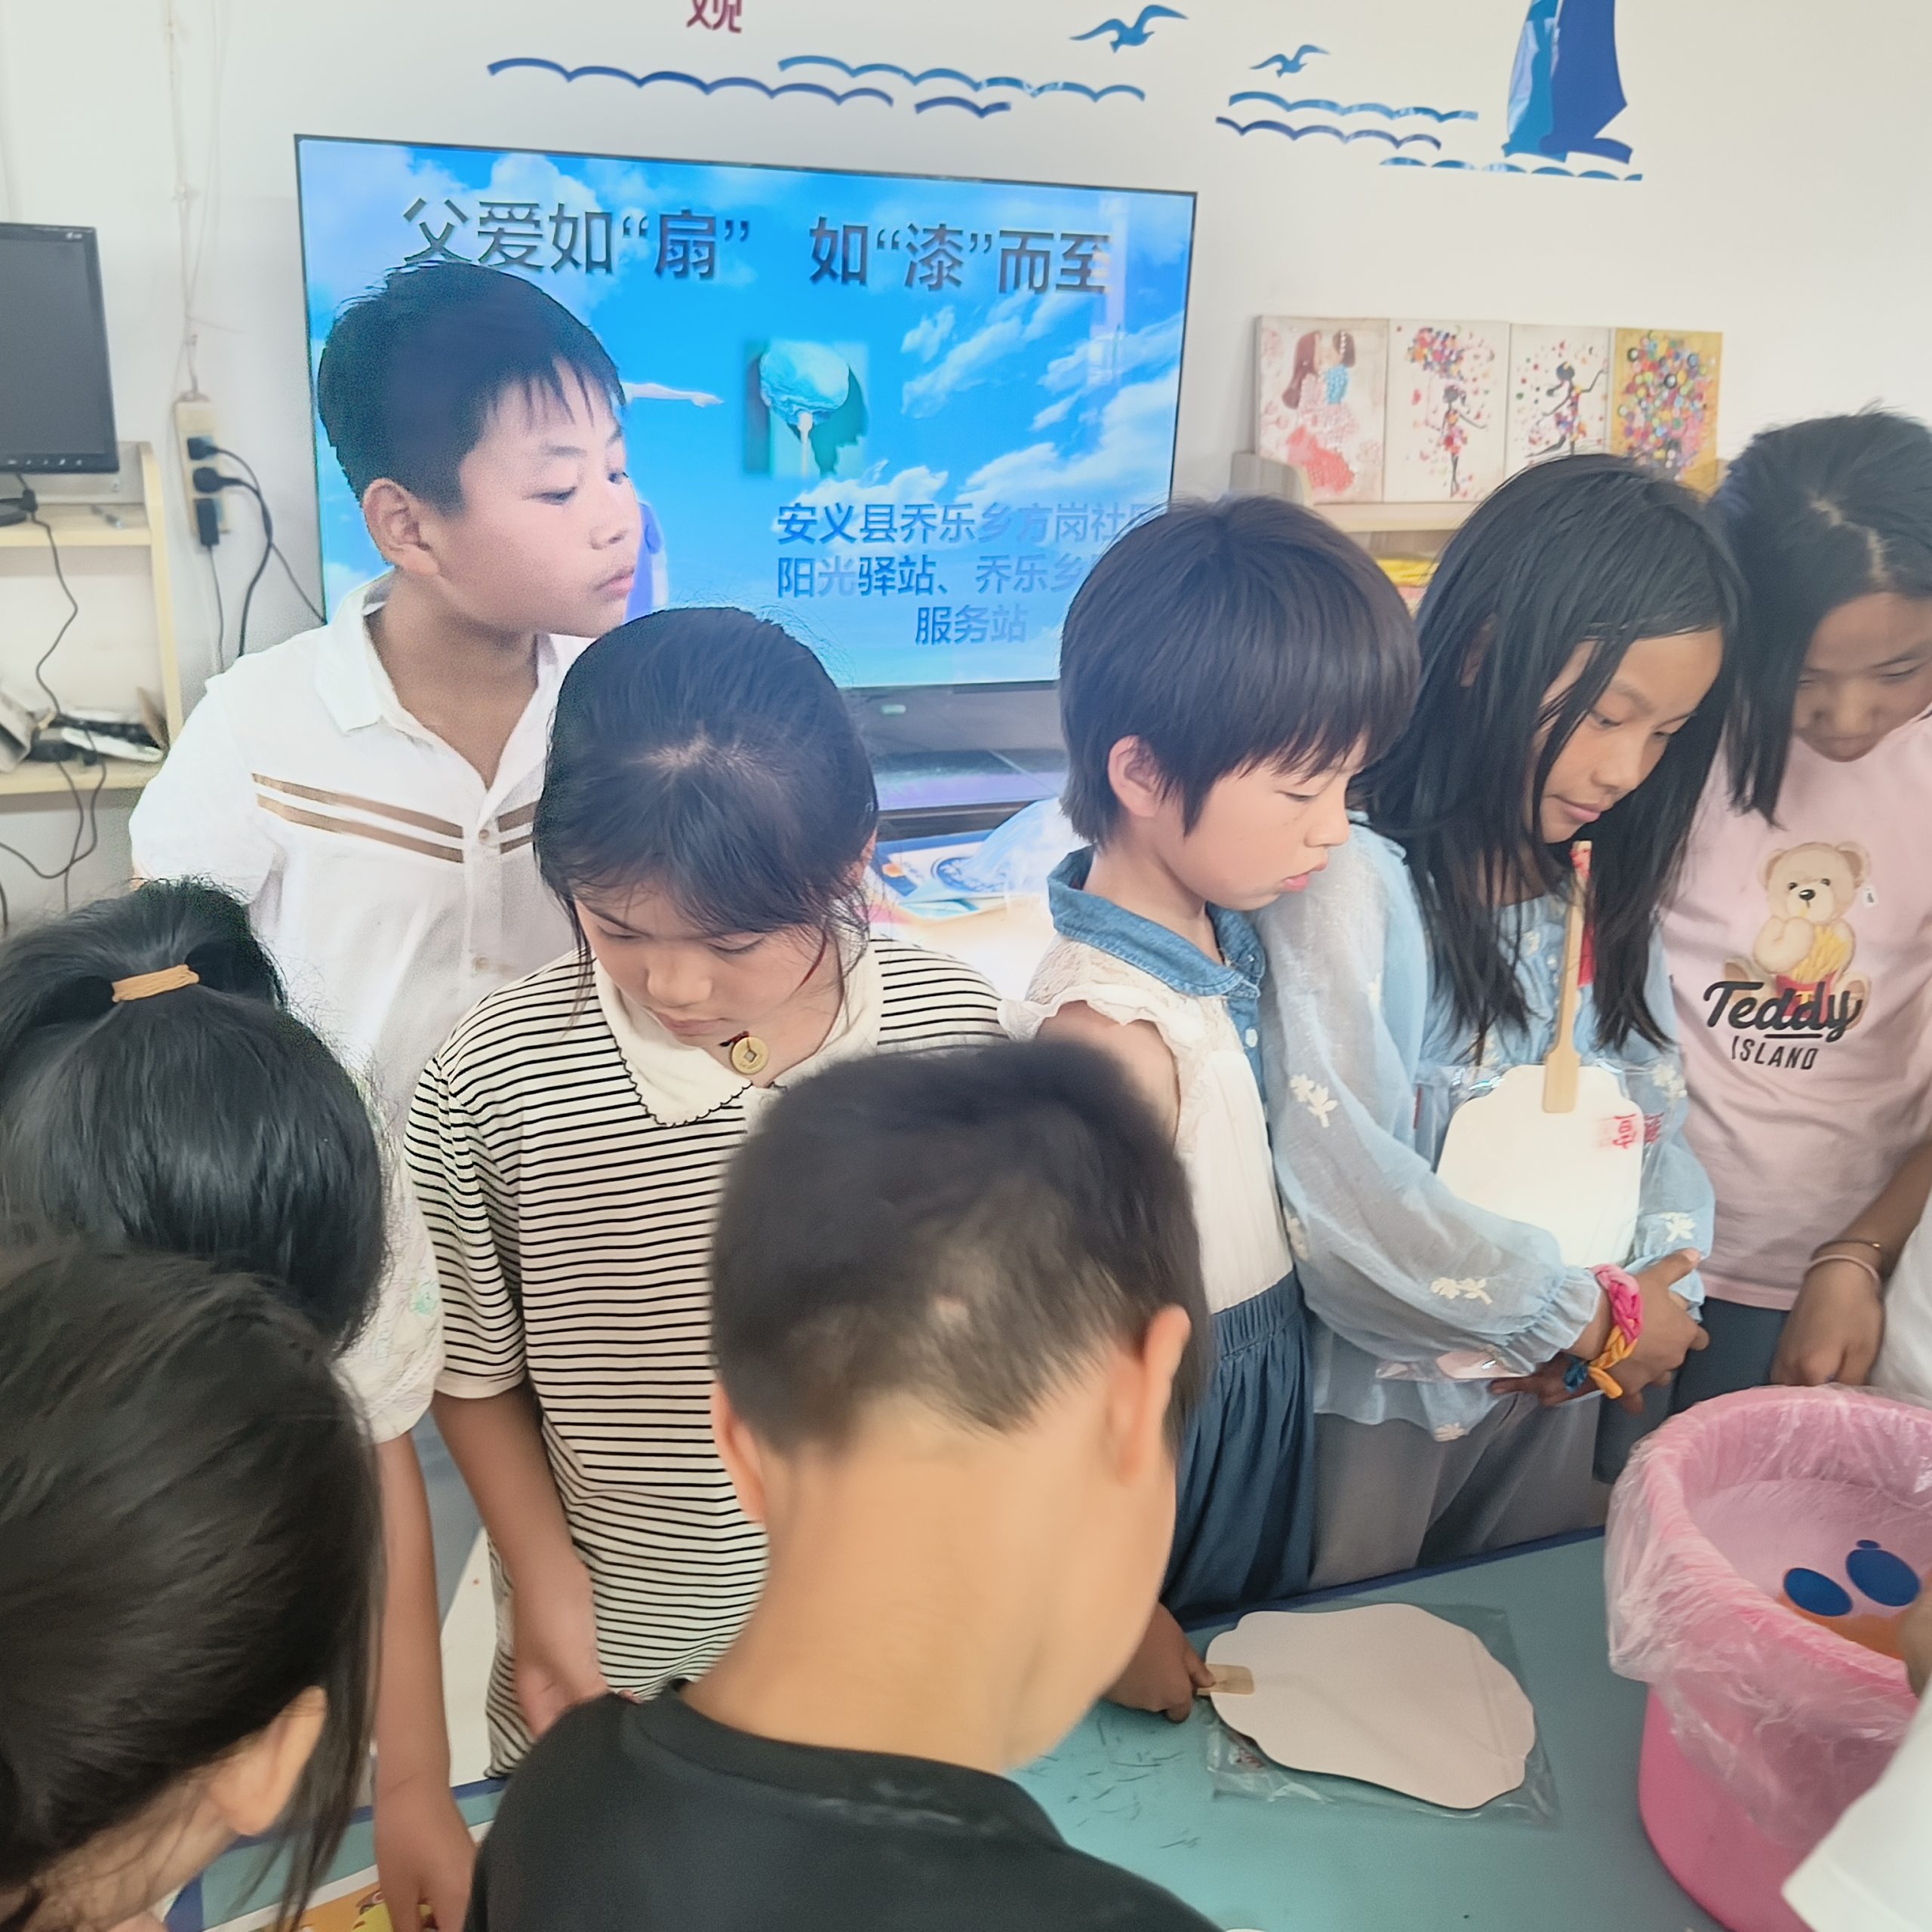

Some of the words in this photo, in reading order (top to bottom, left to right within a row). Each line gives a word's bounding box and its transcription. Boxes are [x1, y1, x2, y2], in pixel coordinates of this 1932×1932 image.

[403, 198, 750, 280] 父爱如“扇”
[809, 216, 1111, 295] 如“漆”而至
[777, 502, 1151, 545] 安义县乔乐乡方岗社
[915, 605, 1028, 646] 服务站
[1703, 980, 1863, 1042] Teddy
[1731, 1035, 1819, 1070] ISLAND
